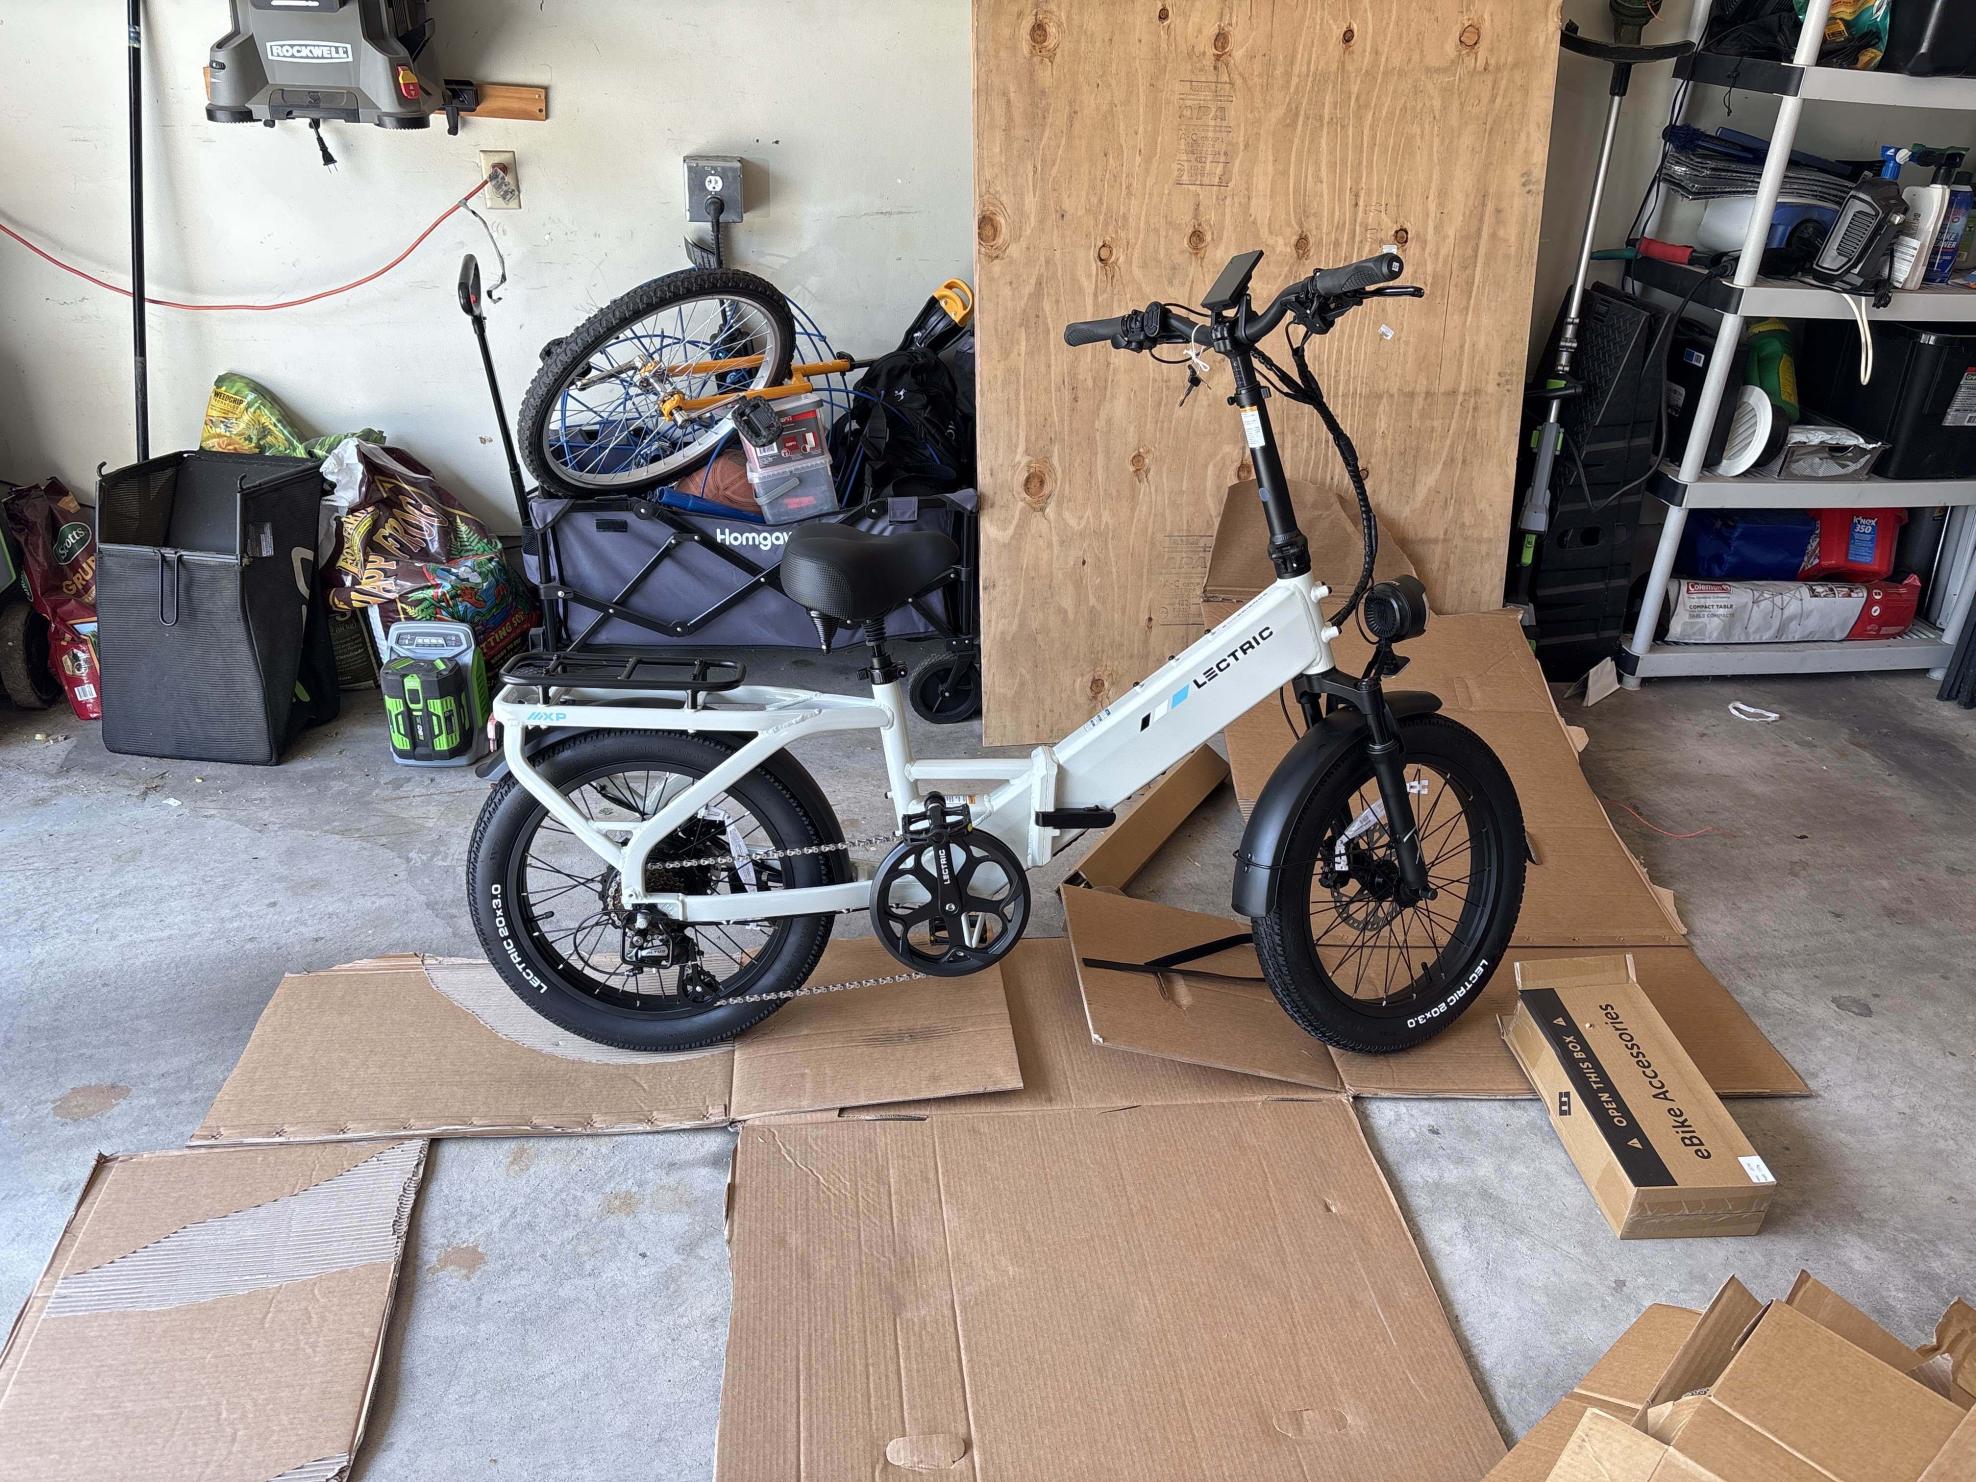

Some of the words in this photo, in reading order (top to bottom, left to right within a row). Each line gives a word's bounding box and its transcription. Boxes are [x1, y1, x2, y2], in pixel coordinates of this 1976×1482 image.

[271, 45, 348, 58] ROCKWELL
[213, 390, 244, 406] WEEDGRIP
[59, 527, 85, 560] Scotts
[372, 495, 449, 560] FROG
[1854, 524, 1873, 534] 350
[480, 623, 512, 653] TTING
[1193, 626, 1274, 690] LECTRIC
[938, 848, 951, 886] LECTRIC
[491, 884, 510, 938] 20x3.0
[502, 937, 549, 994] LECTRIC
[1446, 958, 1489, 1006] LECTRIC
[1406, 1002, 1448, 1029] 20x3.0
[1562, 1035, 1588, 1060] BOX
[1598, 1003, 1677, 1103] Accessories
[1579, 1061, 1605, 1091] THIS
[1597, 1092, 1628, 1128] OPEN
[1666, 1106, 1713, 1160] eBike
